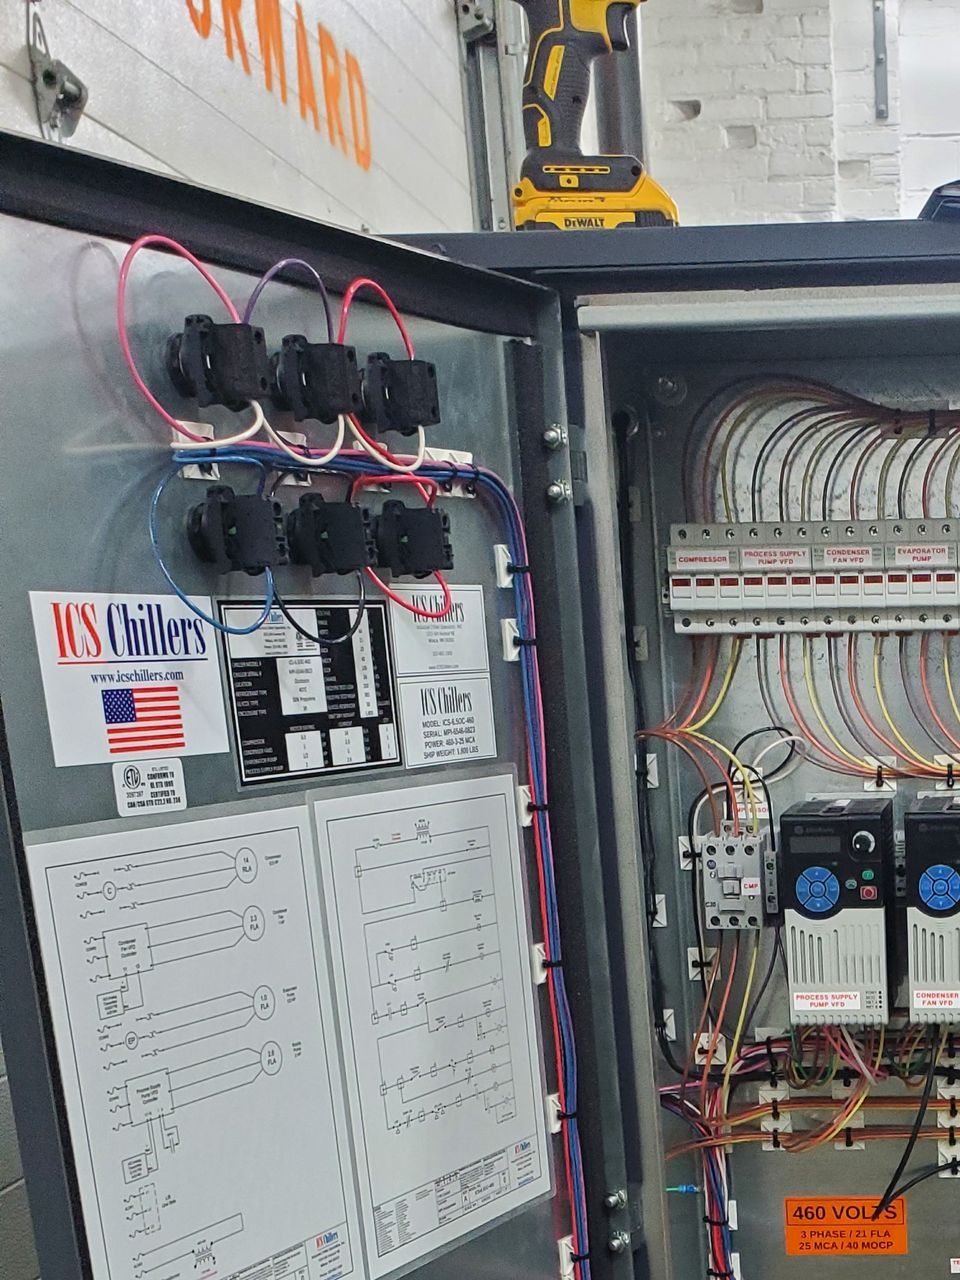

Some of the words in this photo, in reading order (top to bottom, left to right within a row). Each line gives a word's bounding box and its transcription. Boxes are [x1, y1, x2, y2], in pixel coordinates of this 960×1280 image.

[51, 602, 102, 658] ICS
[106, 602, 207, 657] Chillers
[90, 669, 184, 685] www.icschillers.com
[421, 688, 437, 716] ICS
[438, 686, 472, 714] Chillers
[792, 1206, 825, 1220] 460
